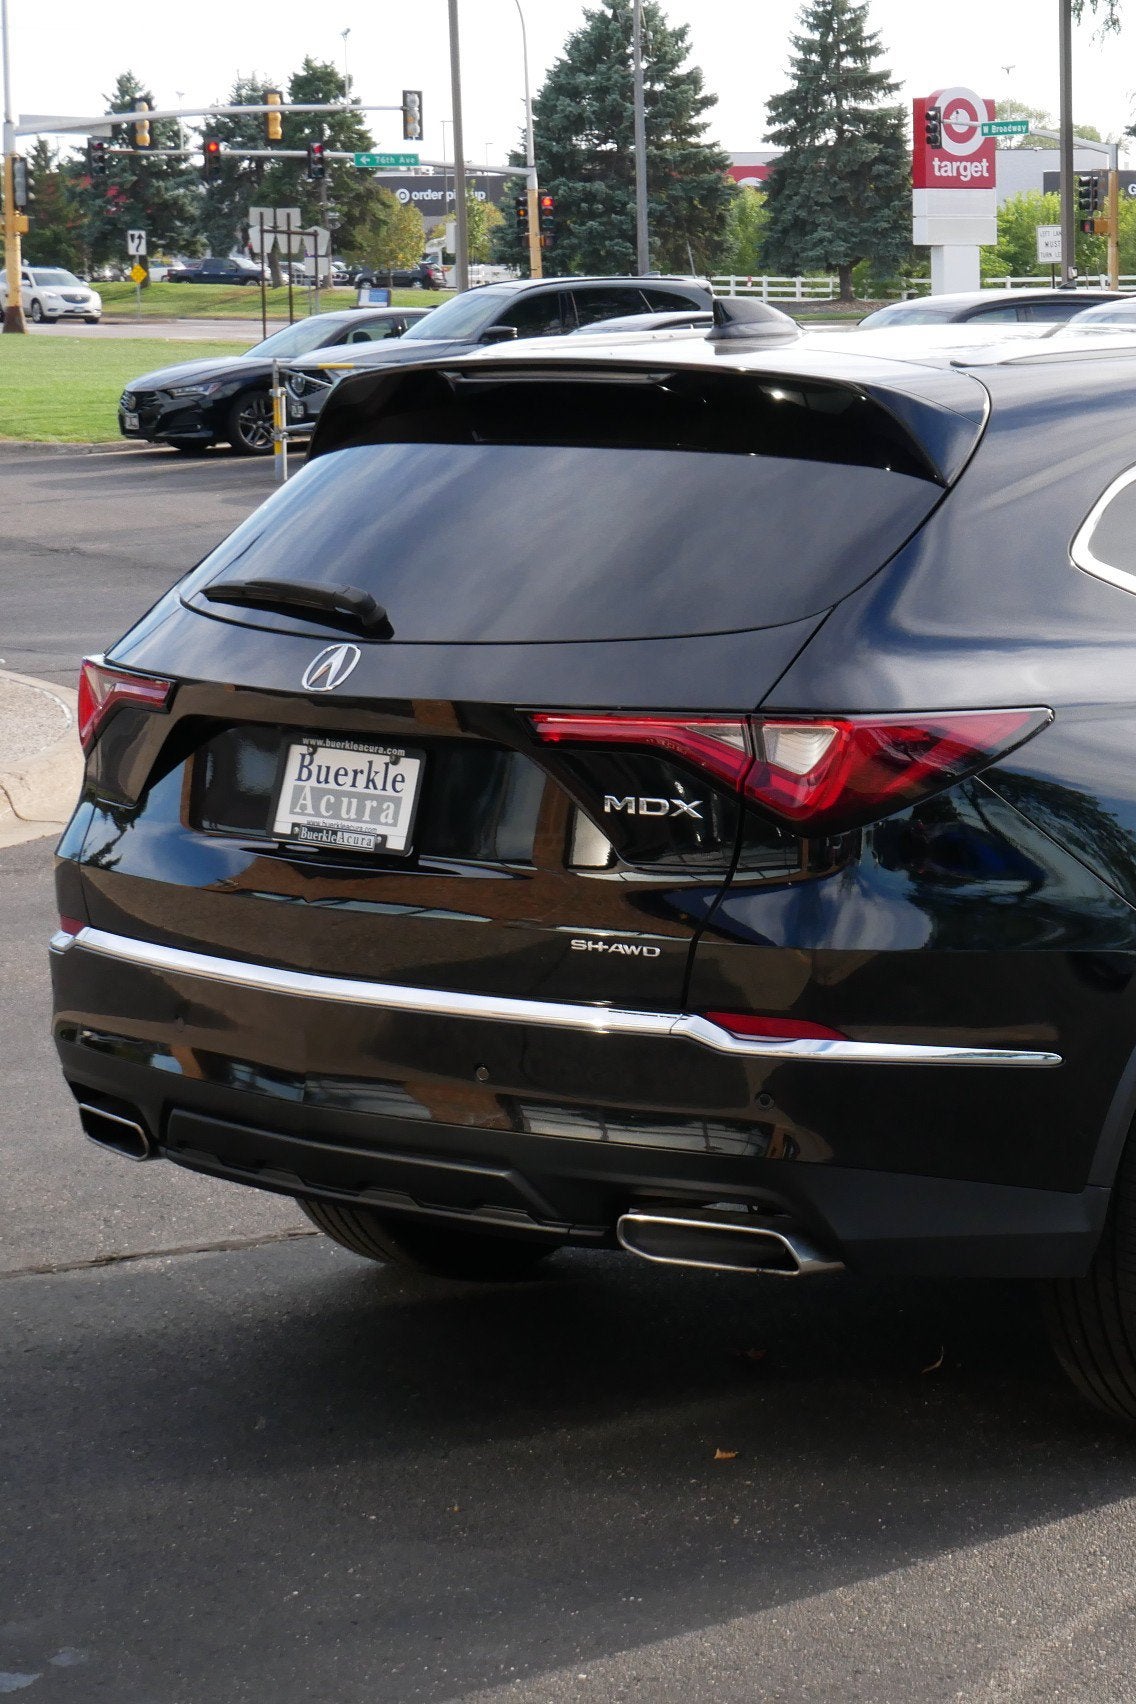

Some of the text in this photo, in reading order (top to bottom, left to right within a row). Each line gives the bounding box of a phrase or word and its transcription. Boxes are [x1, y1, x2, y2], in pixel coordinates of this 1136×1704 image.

[991, 123, 1027, 133] Broadway
[375, 155, 415, 163] 76th Ave
[932, 157, 989, 181] target
[411, 189, 486, 202] order piup
[302, 736, 406, 757] www.buerkleacura.com
[295, 752, 406, 793] Buerkle
[293, 785, 395, 824] Acura
[603, 795, 704, 819] MDX
[570, 939, 661, 957] SH-AWD
